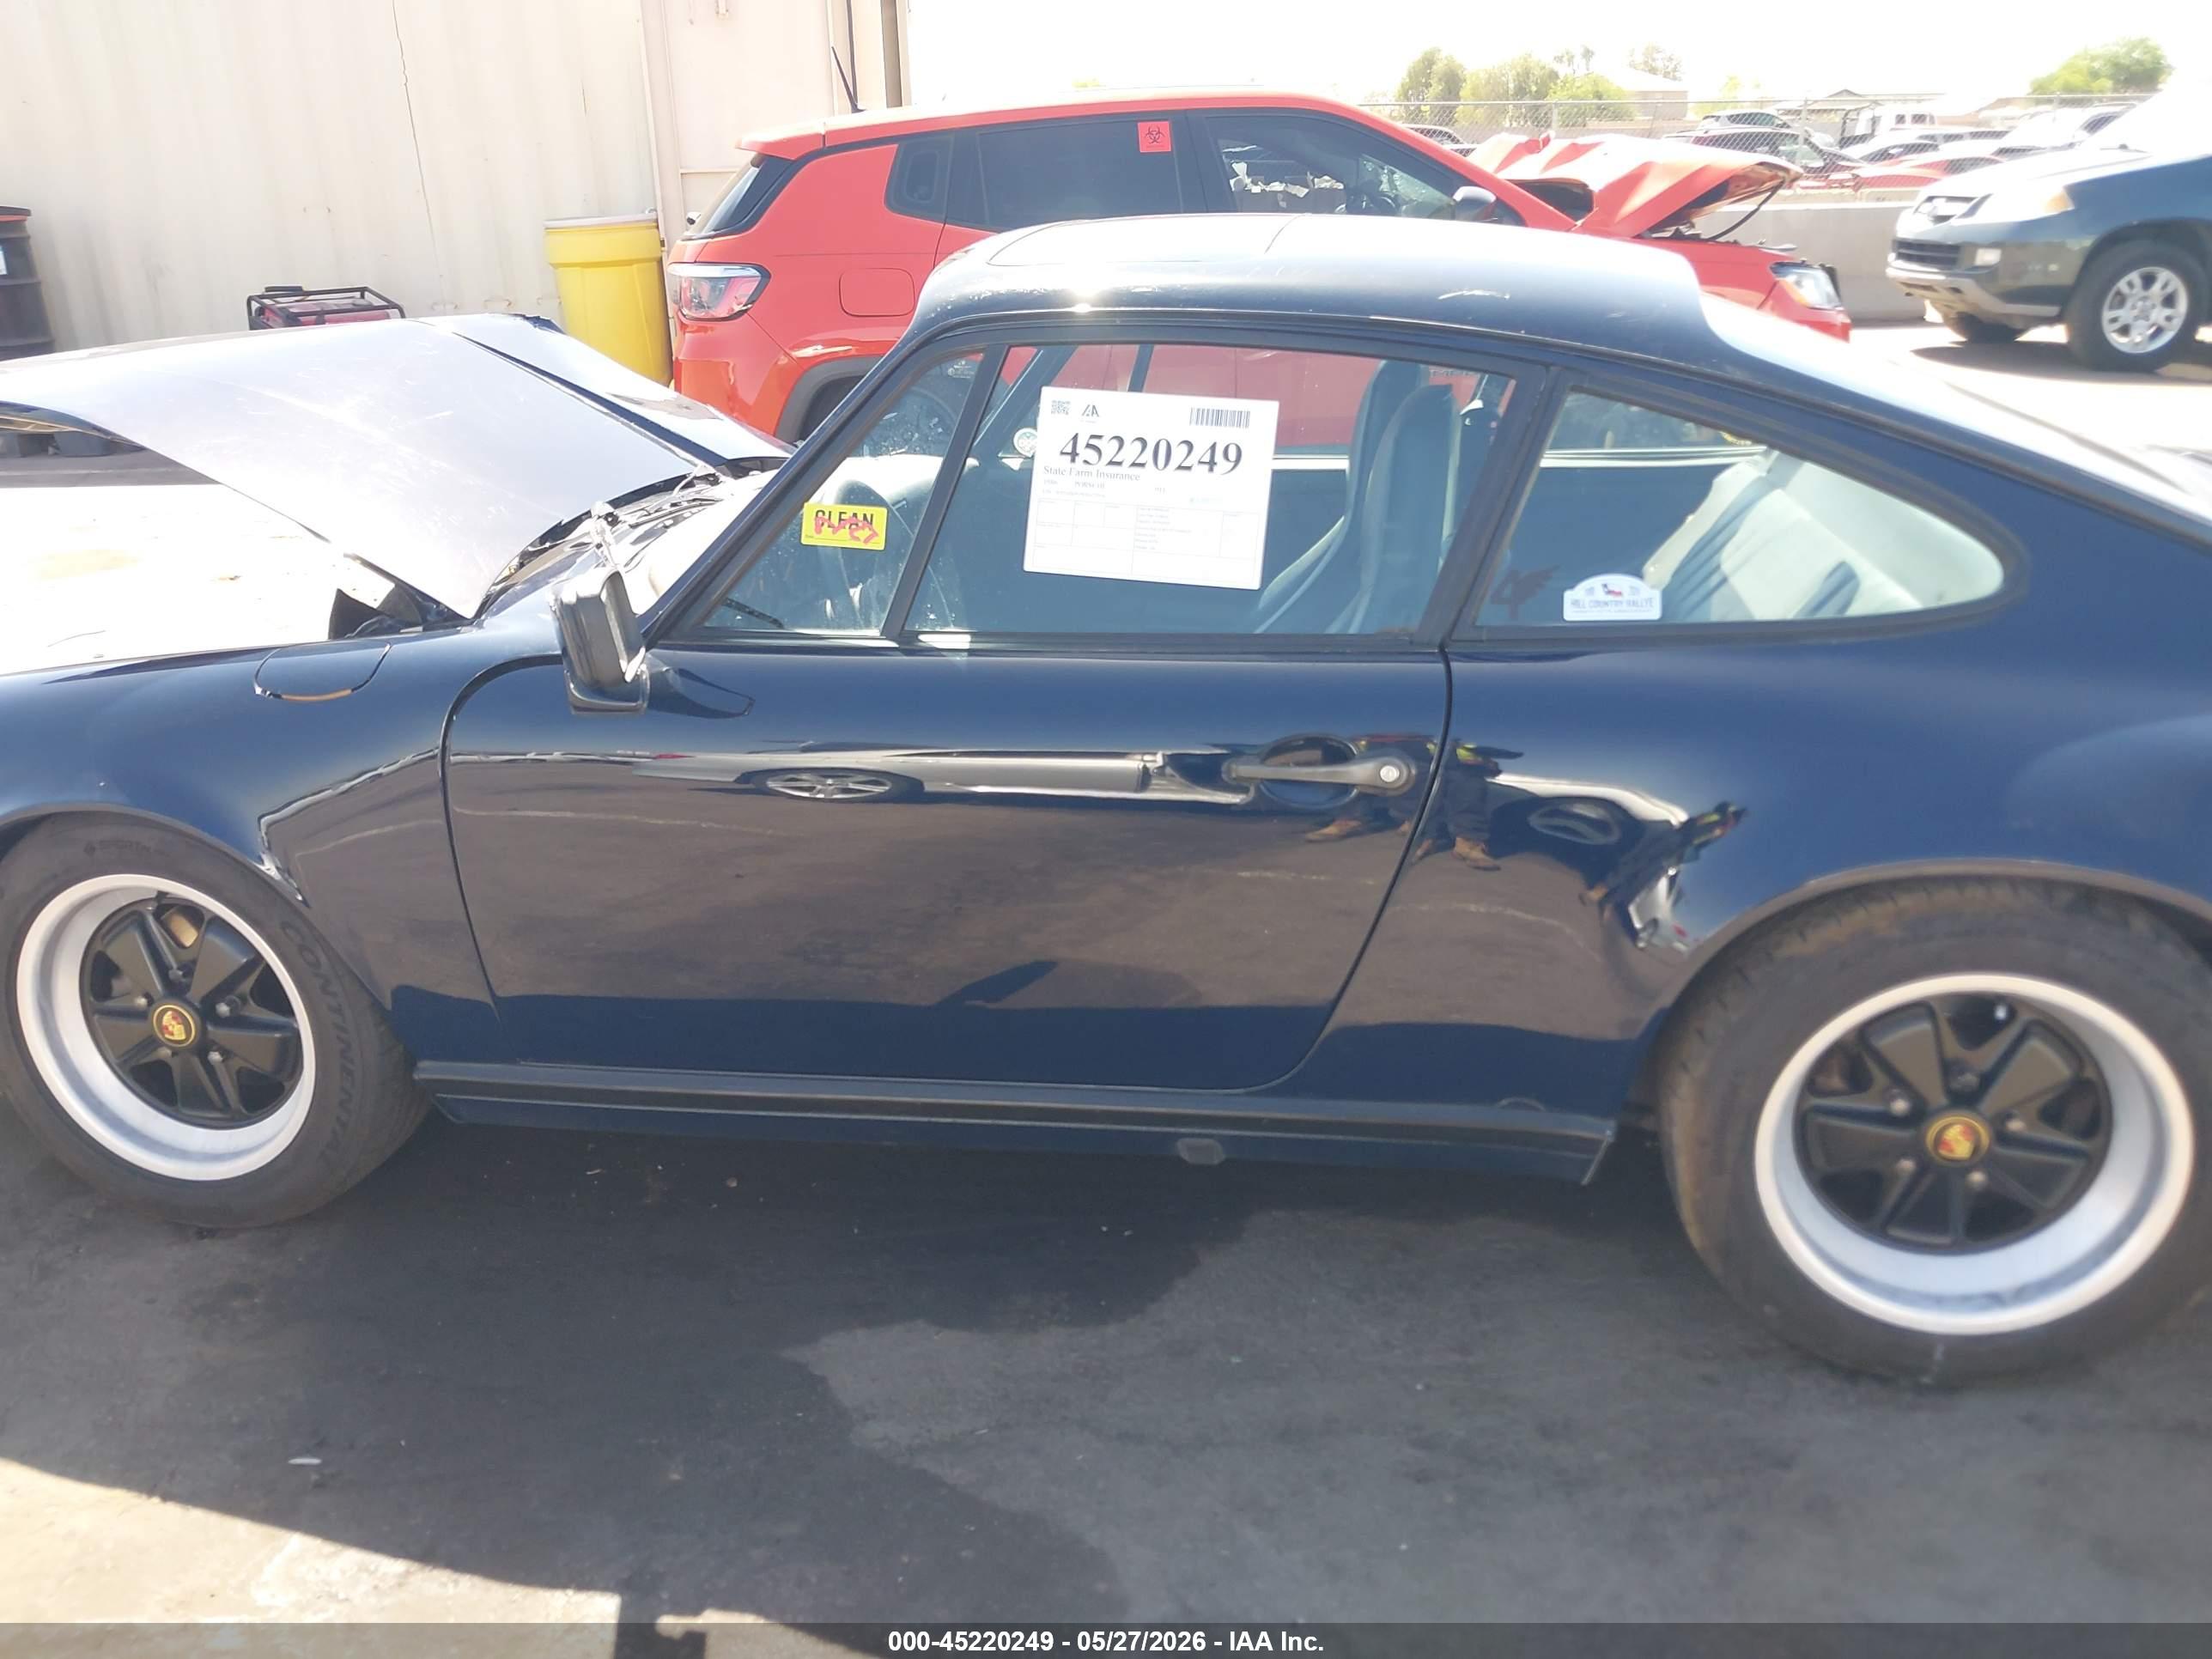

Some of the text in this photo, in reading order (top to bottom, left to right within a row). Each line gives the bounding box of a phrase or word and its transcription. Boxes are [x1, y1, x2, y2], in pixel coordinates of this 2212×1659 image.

[1059, 432, 1243, 475] 45220249
[1043, 465, 1141, 482] State Farm Insurance
[815, 509, 874, 530] CLEAN
